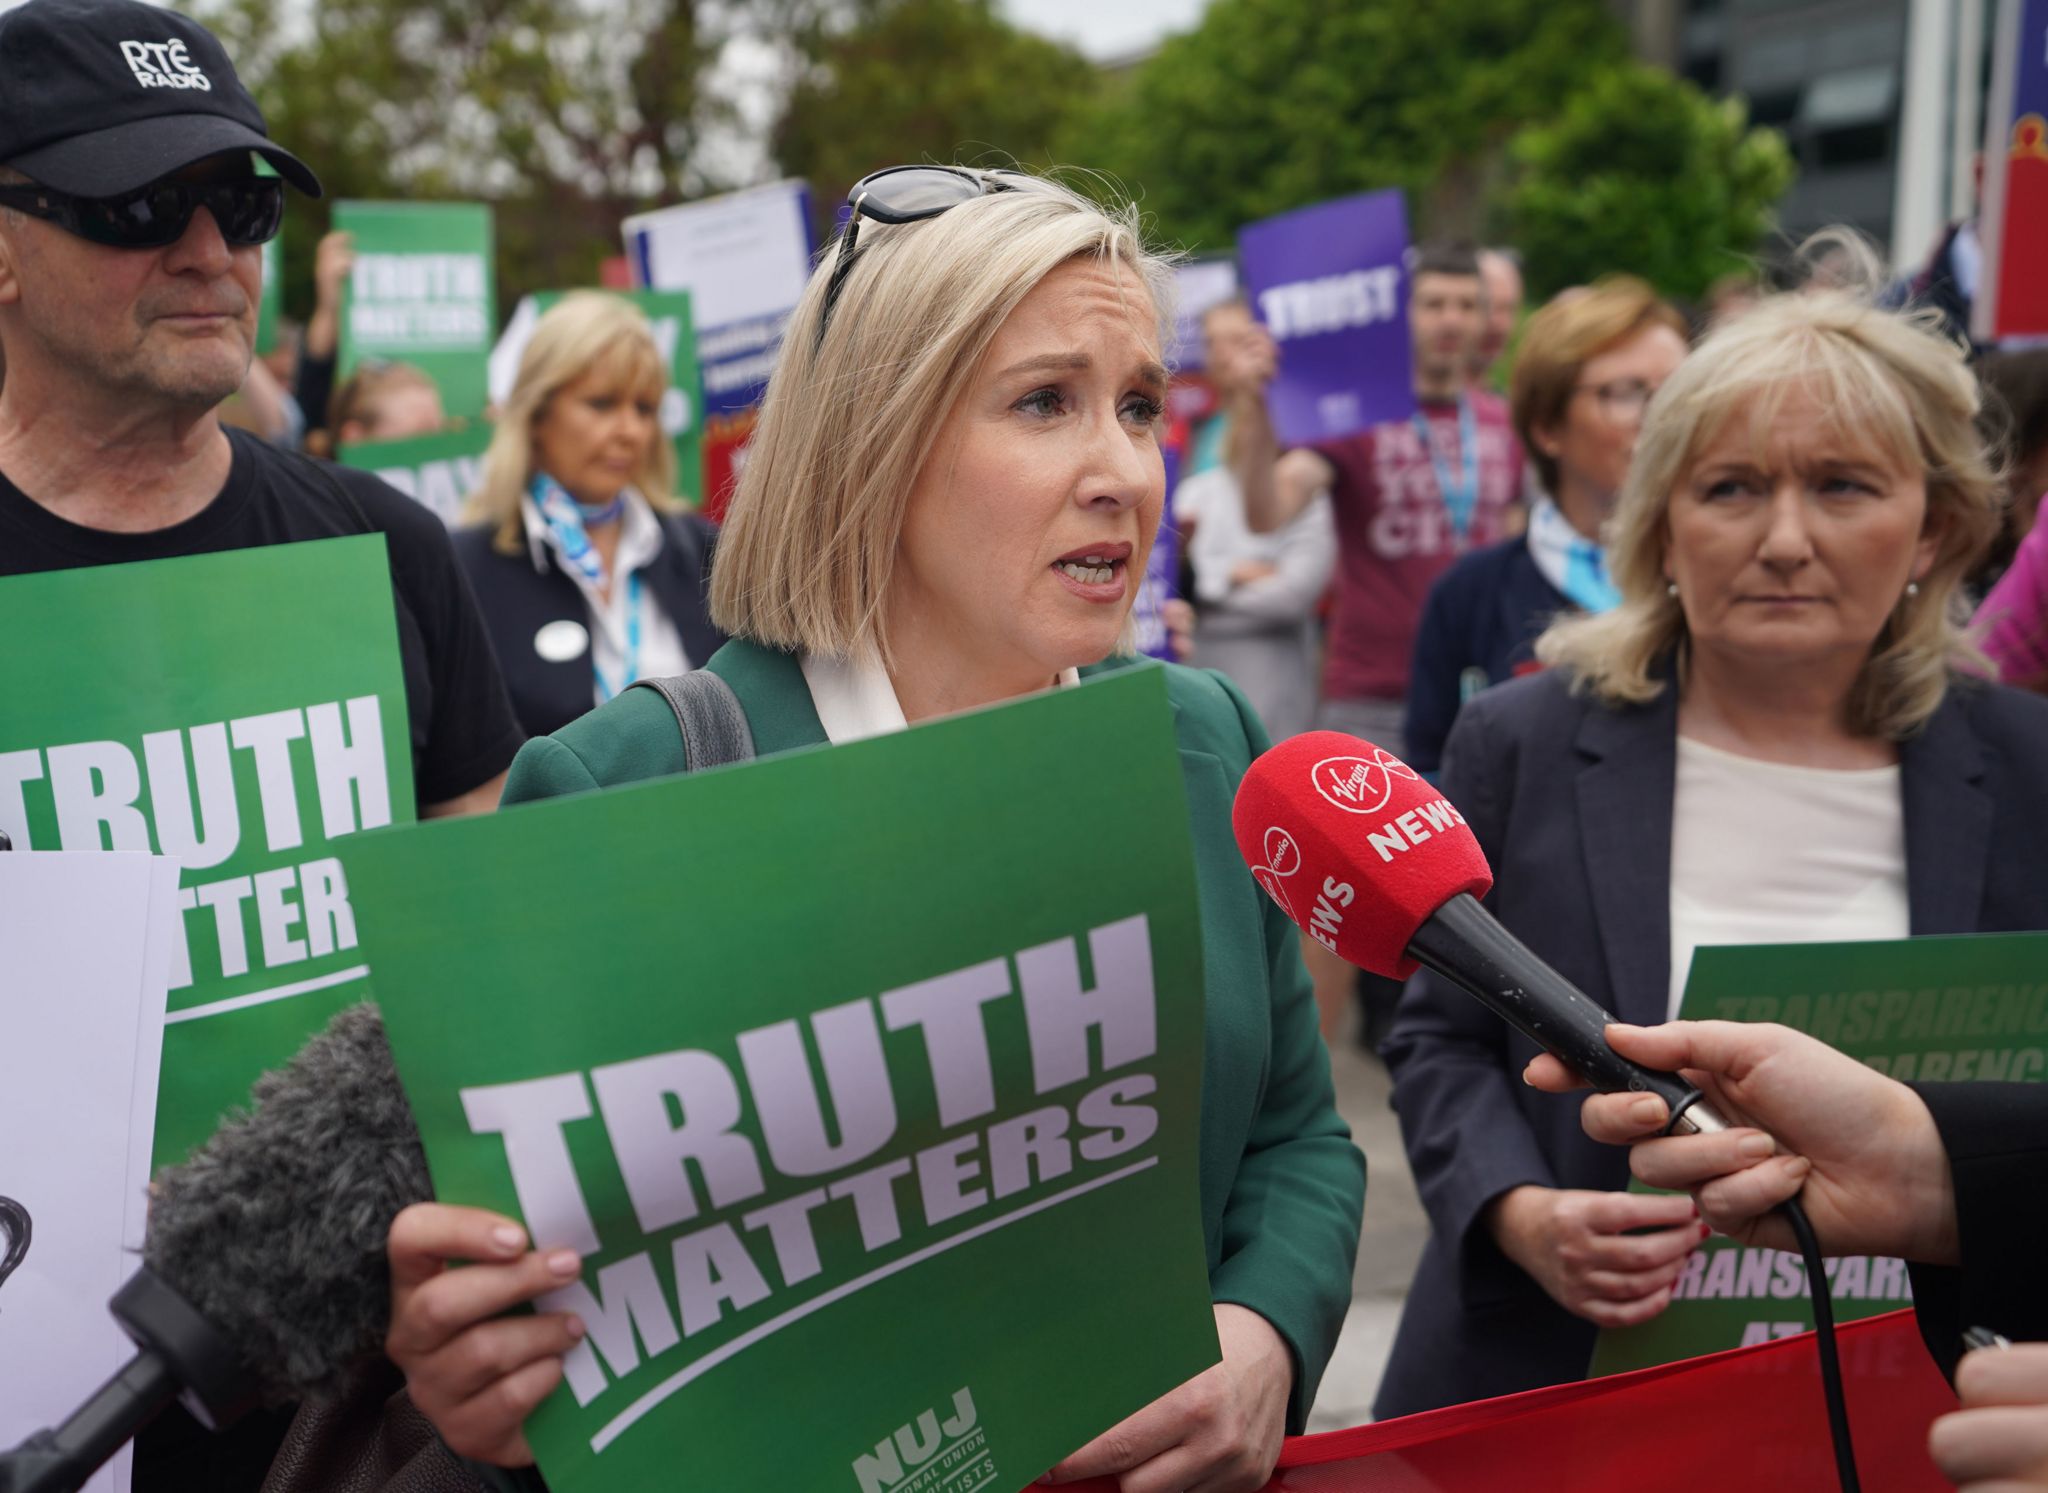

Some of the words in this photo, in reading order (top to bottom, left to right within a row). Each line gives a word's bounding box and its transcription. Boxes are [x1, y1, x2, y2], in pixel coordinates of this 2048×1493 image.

[134, 71, 212, 92] RADIO
[1258, 264, 1400, 341] TRUST
[0, 695, 391, 869] TRUTH
[1331, 763, 1378, 801] Virgin
[1273, 838, 1290, 870] media
[1366, 800, 1466, 863] NEWS
[167, 857, 358, 990] TTER
[1310, 875, 1355, 952] EWS
[459, 913, 1158, 1257] TRUTH
[535, 1074, 1160, 1409] MATTERS
[851, 1385, 977, 1493] NUJ
[898, 1467, 939, 1493] ONAL
[942, 1432, 985, 1469] UNION
